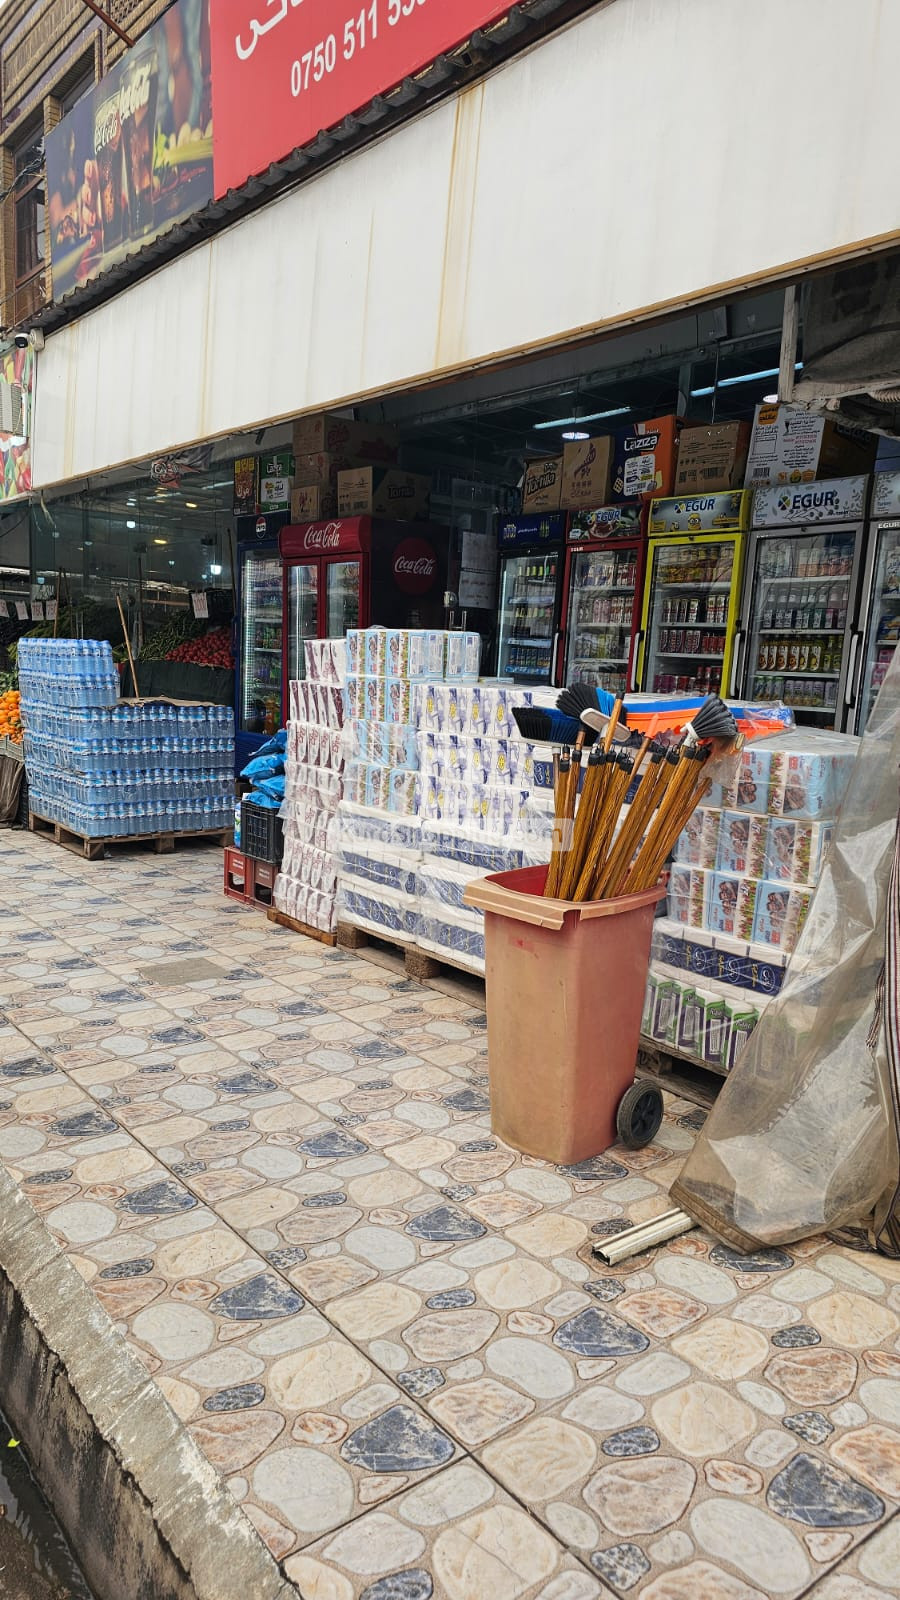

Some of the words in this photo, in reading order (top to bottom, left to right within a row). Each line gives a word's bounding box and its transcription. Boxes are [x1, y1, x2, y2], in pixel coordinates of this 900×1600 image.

[291, 33, 337, 97] 0750
[343, 0, 378, 60] 511
[685, 498, 715, 512] EGUR
[792, 491, 836, 510] EGUR
